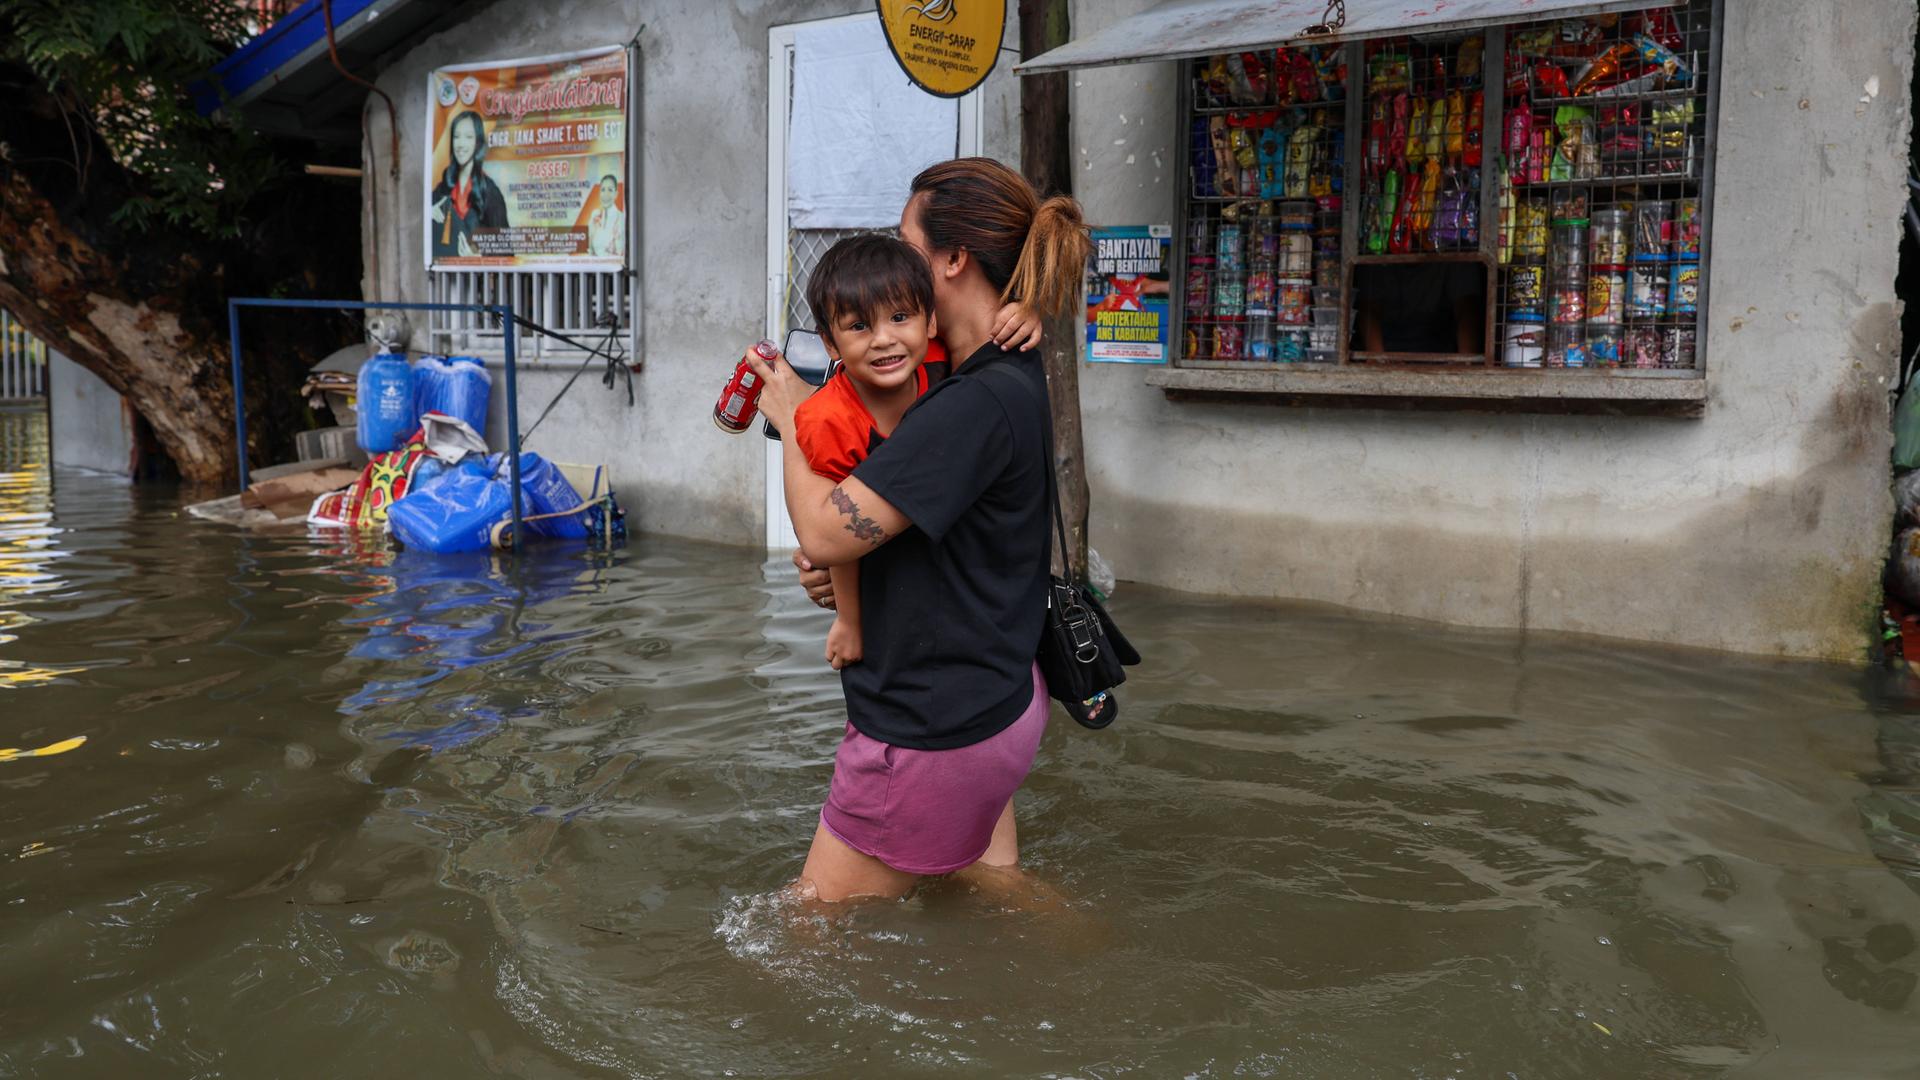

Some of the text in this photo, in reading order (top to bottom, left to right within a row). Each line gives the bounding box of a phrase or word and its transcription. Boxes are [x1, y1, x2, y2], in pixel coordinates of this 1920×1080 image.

[910, 24, 976, 51] ENERGY-SARAP
[528, 160, 570, 177] PASSER
[472, 233, 496, 242] MAYOR
[550, 232, 586, 241] FAUSTINO
[1098, 238, 1161, 259] BANTAYAN
[1098, 259, 1160, 273] ANG BENTAHAN
[1097, 311, 1159, 326] PROTEKTAHAN
[1096, 327, 1113, 341] ANG
